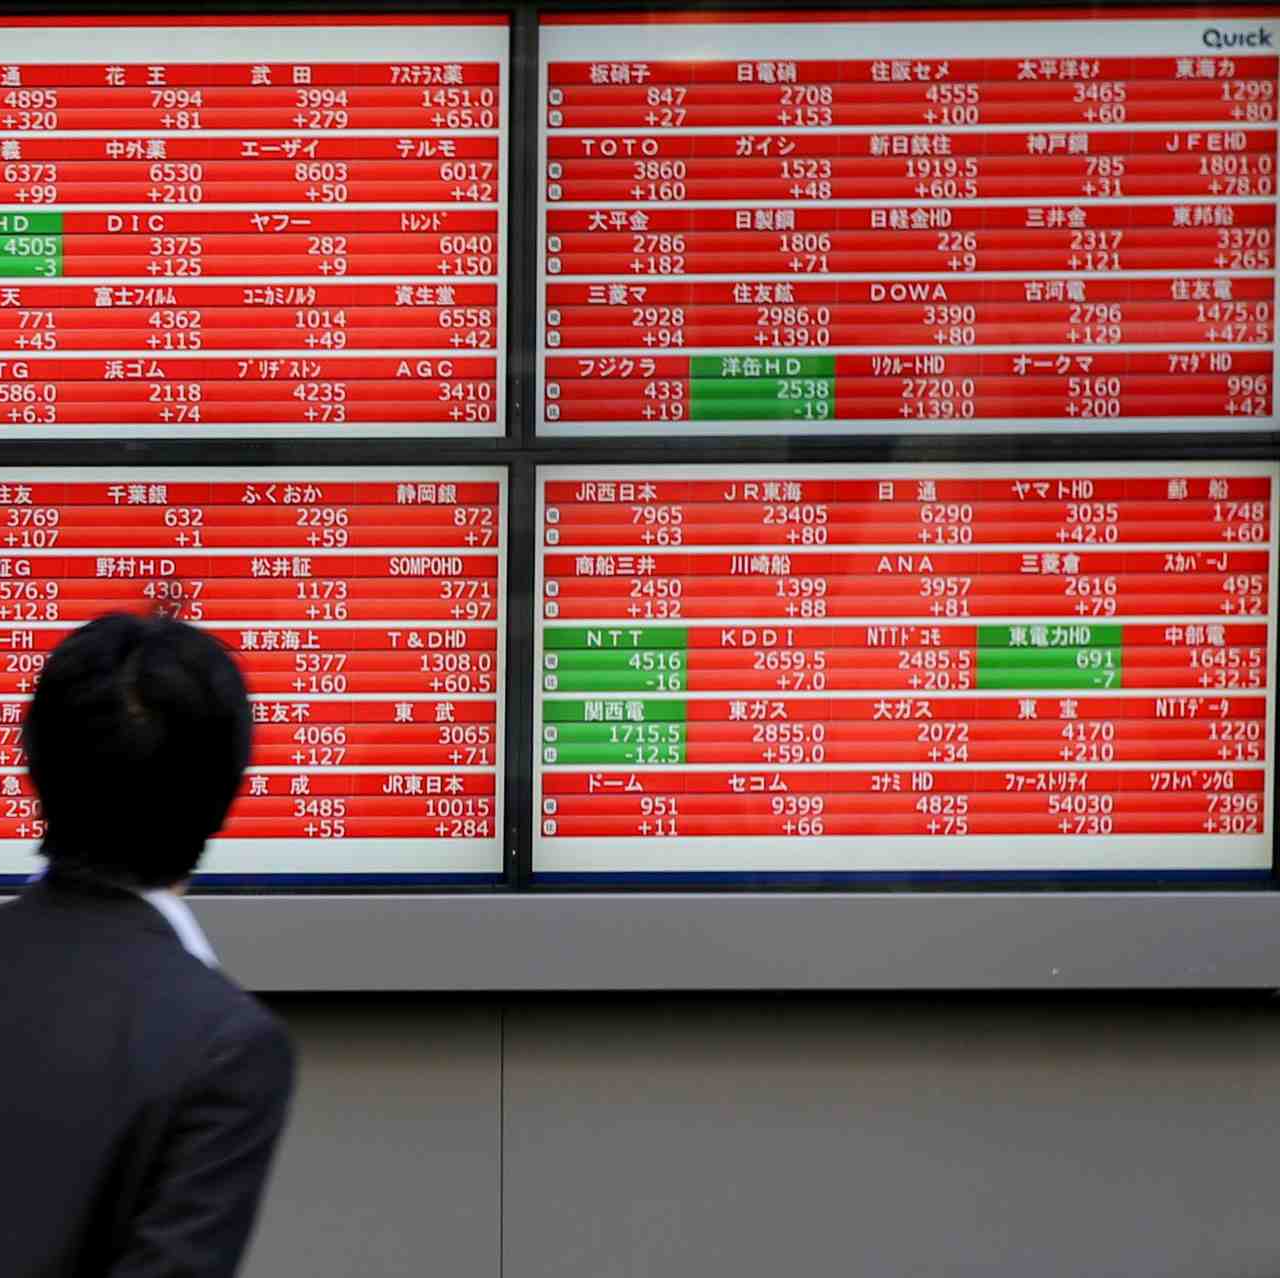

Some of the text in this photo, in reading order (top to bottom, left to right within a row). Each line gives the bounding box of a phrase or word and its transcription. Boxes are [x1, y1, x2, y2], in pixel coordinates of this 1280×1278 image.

[1203, 25, 1272, 49] Quick
[781, 86, 832, 105] 2708
[778, 104, 832, 126] +153
[397, 140, 455, 157] テルモ
[441, 163, 492, 181] 6017
[907, 159, 977, 177] 1919.5
[451, 184, 492, 202] +42
[915, 180, 977, 199] +60.5
[589, 211, 648, 230] 大平金
[4, 237, 56, 256] 4505
[634, 235, 685, 253] 2786
[35, 255, 56, 277] -3
[630, 252, 684, 274] +182
[396, 285, 455, 305] 資生堂
[439, 309, 491, 327] 6558
[450, 330, 490, 348] +42
[105, 360, 164, 379] 浜ゴム
[579, 358, 655, 377] フジクラ
[1014, 355, 1093, 375] オークマ
[150, 384, 200, 401] 2118
[645, 381, 683, 400] 433
[1069, 378, 1120, 396] 5160
[160, 405, 200, 422] +74
[642, 399, 683, 421] +19
[1066, 399, 1120, 418] +200
[576, 483, 656, 501] JR西日本
[8, 509, 58, 526] 3769
[632, 506, 682, 524] 7965
[4, 530, 58, 548] +107
[641, 527, 682, 546] +63
[241, 630, 320, 650] 東京海上
[296, 654, 346, 672] 5377
[629, 652, 680, 670] 4516
[292, 675, 346, 694] +160
[646, 669, 680, 691] -16
[585, 701, 644, 721] 関西電
[729, 700, 787, 720] 東ガス
[610, 725, 679, 743] 1715.5
[753, 724, 824, 742] 2855.0
[626, 742, 679, 763] -12.5
[763, 741, 824, 763] +59.0
[383, 775, 463, 794] JR東日本
[729, 774, 787, 792] セコム
[427, 799, 488, 816] 10015
[772, 797, 823, 815] 9399
[435, 820, 488, 837] +284
[782, 814, 823, 836] +66
